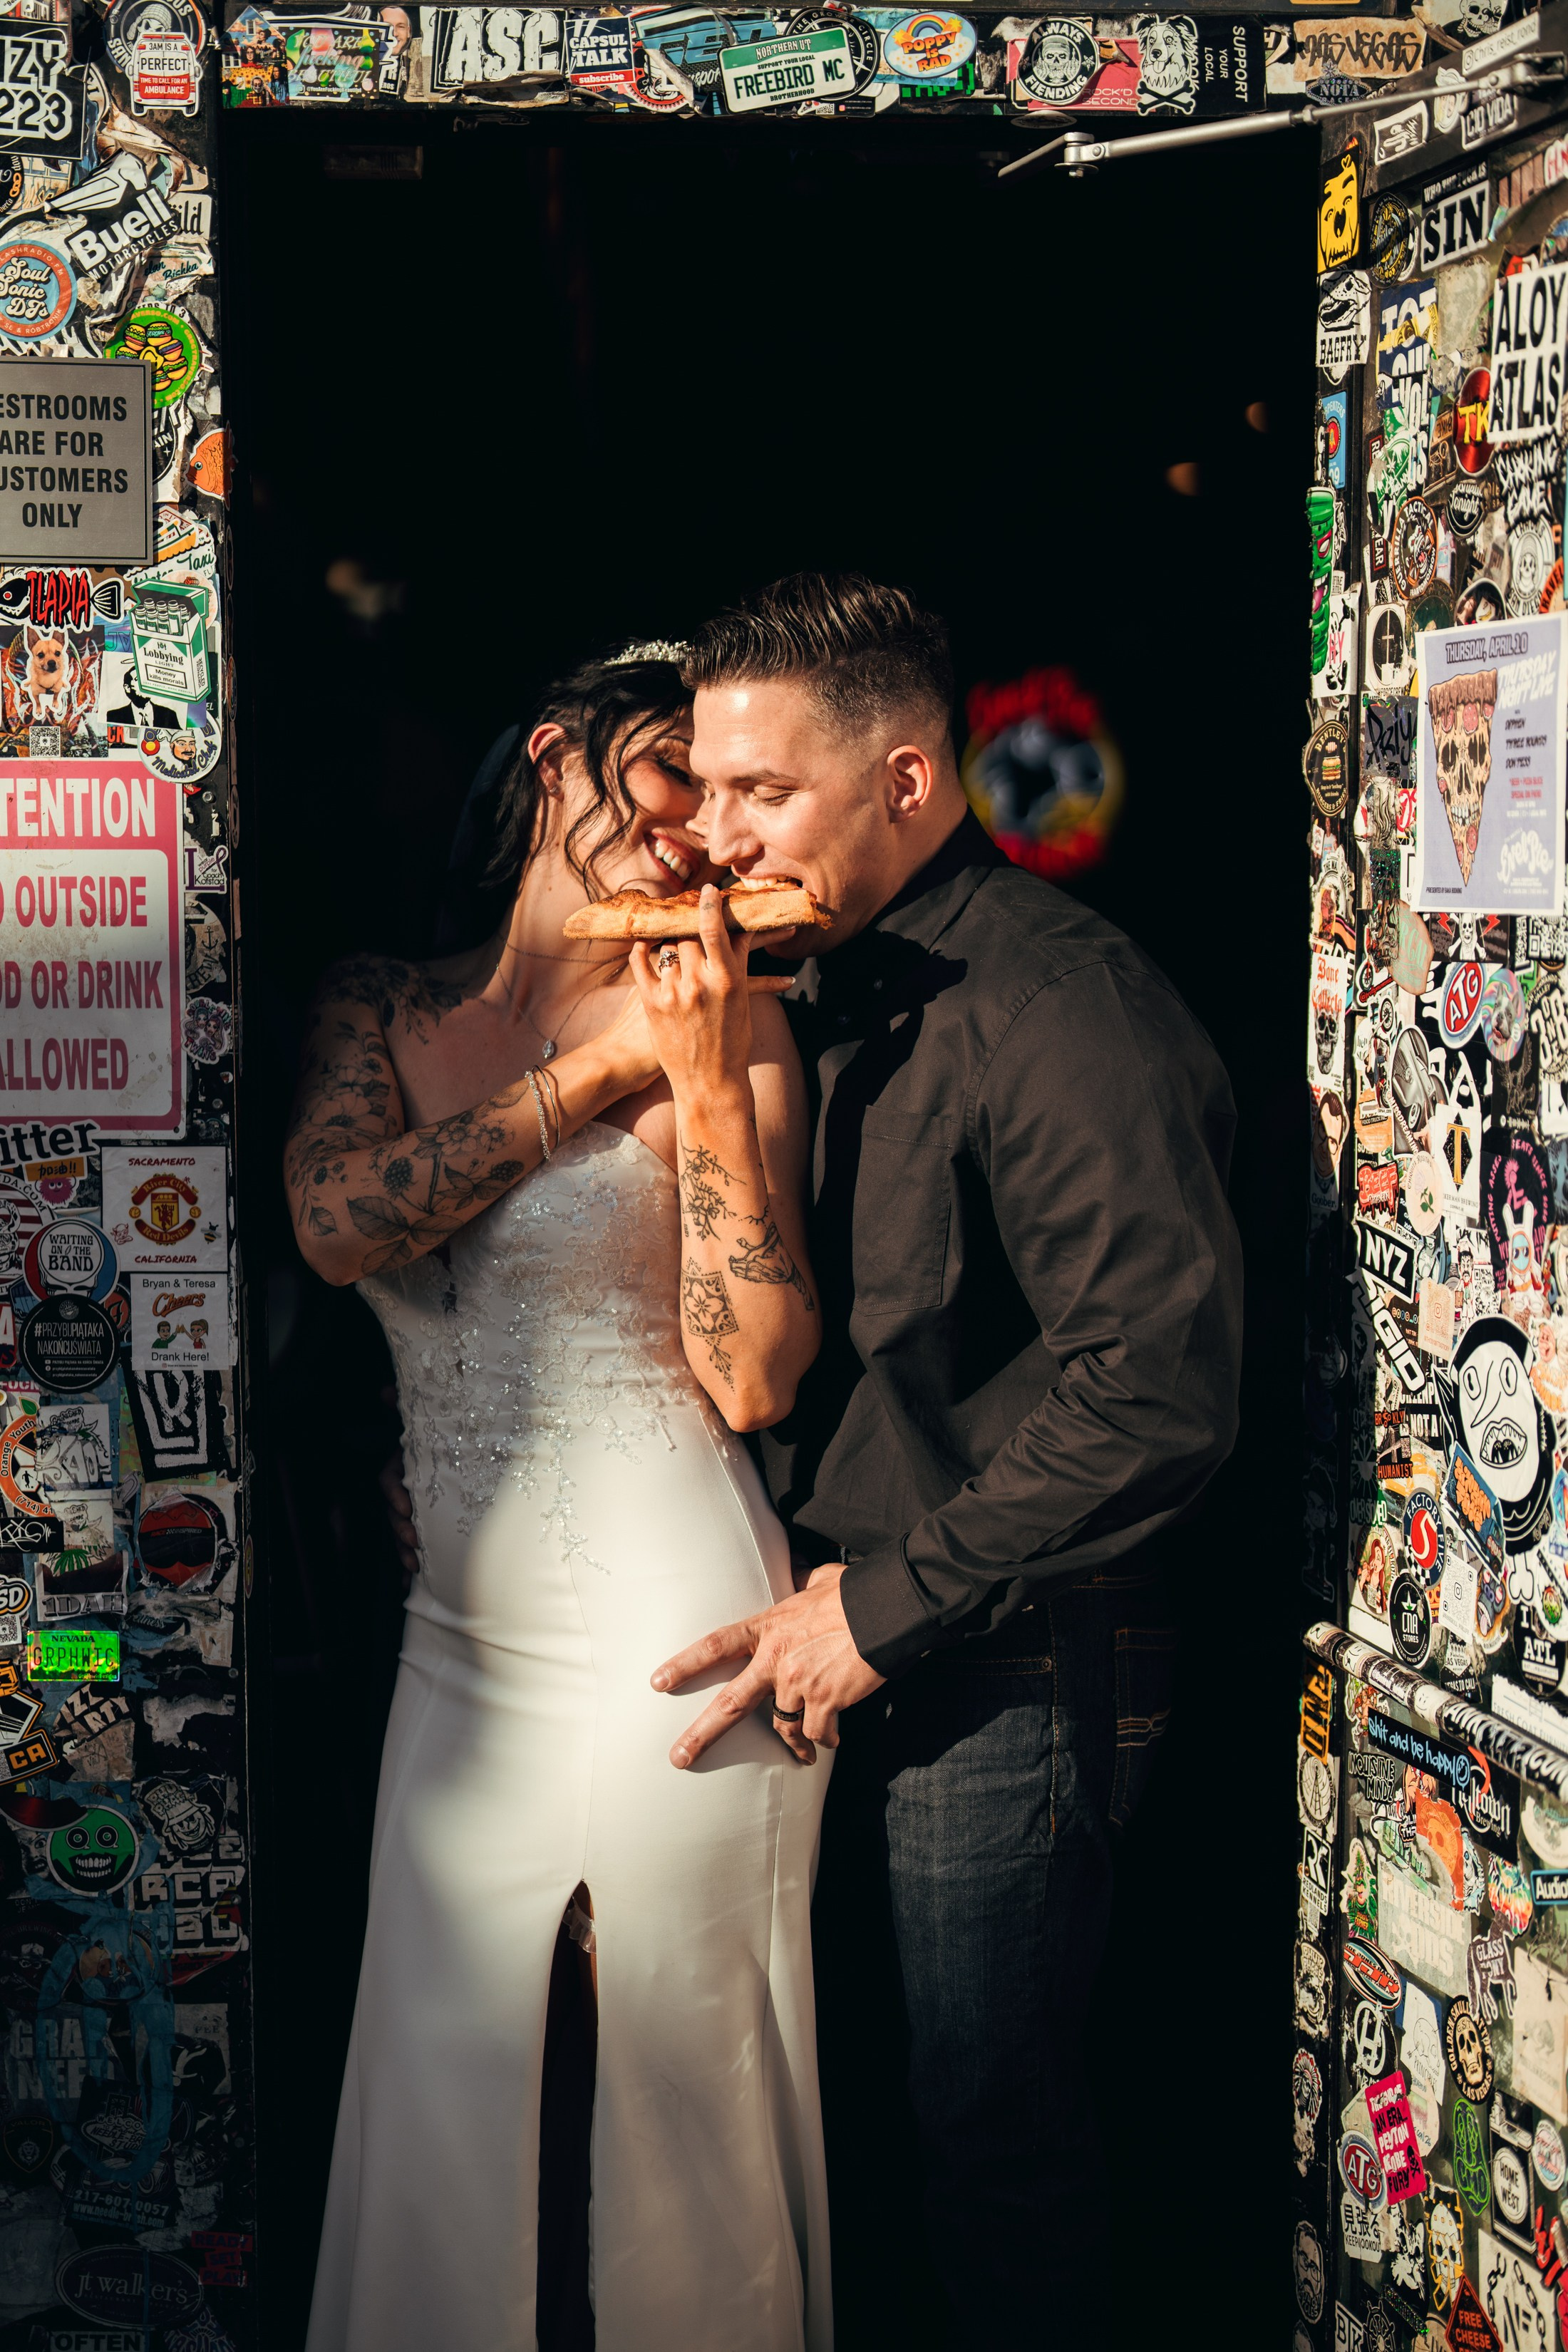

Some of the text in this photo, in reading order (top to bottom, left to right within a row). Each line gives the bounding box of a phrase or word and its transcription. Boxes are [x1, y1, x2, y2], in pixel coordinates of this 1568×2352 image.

[293, 35, 363, 49] YOU ARE
[569, 33, 628, 49] CAPSUL
[793, 11, 874, 61] THE GROWER CIRCLE
[901, 31, 957, 54] POPPY
[1031, 23, 1085, 44] ALWAYS
[149, 43, 163, 51] 3AM
[292, 43, 365, 72] fucking
[575, 48, 629, 67] TALK
[755, 41, 798, 61] NORTHERN
[800, 38, 812, 52] UT
[140, 57, 187, 71] PERFECT
[758, 60, 783, 70] SUPPORT
[917, 55, 952, 72] RAD
[1204, 47, 1214, 83] LOCAL
[1219, 48, 1227, 78] YOUR
[1232, 25, 1248, 103] SUPPORT
[288, 69, 372, 83] BEAUTIFUL
[579, 73, 625, 84] subscribe
[733, 58, 845, 99] FREEBIRD MC
[1023, 72, 1090, 100] FIENDING
[144, 86, 185, 95] AMBULANCE
[770, 88, 815, 102] BROTHERHOOD
[1320, 84, 1359, 97] NOTA
[1486, 93, 1513, 127] VIDA
[1424, 175, 1458, 203] WHO THE
[68, 188, 173, 271] Buell
[1423, 190, 1487, 264] SIN
[88, 218, 179, 282] MOTORCYCLES
[5, 257, 51, 282] Soul
[0, 274, 46, 299] Sonic
[1494, 272, 1567, 356] ALOY
[1319, 334, 1367, 365] BAGFRY
[1489, 355, 1562, 433] ATLAS
[0, 430, 104, 457] ARE FOR
[22, 502, 83, 528] ONLY
[1393, 501, 1435, 591] GUERRILLA TACTICAL
[144, 647, 184, 666] Lobbying
[1445, 631, 1530, 664] THURSDAY, APRIL 10
[155, 669, 176, 679] Money
[163, 677, 185, 686] morals
[1497, 651, 1557, 689] THURSDAY
[153, 740, 218, 779] Medicated Chef
[0, 777, 156, 837] TENTION
[198, 855, 216, 873] purple
[15, 875, 148, 927] OUTSIDE
[1317, 956, 1339, 983] Bone
[31, 961, 164, 1009] OR DRINK
[1450, 968, 1478, 1031] ATG
[185, 1036, 216, 1061] TWINS
[128, 1157, 196, 1167] SACRAMENTO
[143, 1178, 187, 1193] River City
[1487, 1192, 1501, 1242] PUTTING
[1511, 1138, 1534, 1157] SEATS
[49, 1234, 93, 1246] WAITING
[143, 1224, 189, 1242] Red Devils
[51, 1245, 91, 1255] ON THE
[134, 1254, 197, 1264] CALIFORNIA
[1366, 1228, 1409, 1284] NYZ
[48, 1255, 93, 1272] BAND
[142, 1279, 216, 1289] Bryan & Teresa
[152, 1292, 206, 1318] Cheers
[151, 1352, 210, 1362] Drank Here!
[1, 1420, 36, 1477] Orange Youth
[1377, 1461, 1413, 1480] HUMANIST
[15, 1495, 40, 1514] (714)
[1406, 1495, 1445, 1574] FACTORY FIVE
[1402, 1611, 1419, 1635] CNA
[51, 1635, 96, 1644] NEVADA
[1402, 1634, 1419, 1644] STORES
[1523, 1636, 1557, 1667] ATL
[33, 1646, 114, 1668] GRPHWIC
[1455, 1659, 1468, 1667] VEGAS
[9, 1742, 47, 1770] CA
[1368, 1715, 1456, 1787] shit and be happy
[1475, 1811, 1502, 1838] Brewing
[1301, 1887, 1327, 1914] KENNELS
[1302, 1877, 1328, 1904] REDLANDS
[1475, 1939, 1504, 1961] GLASS
[1346, 1944, 1356, 1956] JOE
[1357, 1952, 1376, 1970] JONES
[1376, 1965, 1399, 1986] RACING
[1480, 1959, 1505, 1979] PONY
[1446, 1999, 1470, 2071] GOLDEN SKULL
[1462, 2071, 1493, 2102] LAS VEGAS
[1374, 2115, 1386, 2135] AN
[1378, 2127, 1409, 2154] PEYTON
[1347, 2149, 1379, 2193] ATG
[1382, 2149, 1407, 2173] KOBE
[1500, 2159, 1520, 2183] HOME
[1387, 2168, 1410, 2194] FURY
[73, 2189, 170, 2217] 217-607-0057
[1500, 2186, 1520, 2213] WEST
[1343, 2204, 1381, 2239] 見張る
[209, 2252, 236, 2265] SET
[74, 2271, 91, 2299] jt
[1458, 2309, 1482, 2330] FREE
[56, 2334, 140, 2352] OFTEN
[1455, 2326, 1492, 2351] CHEESE
